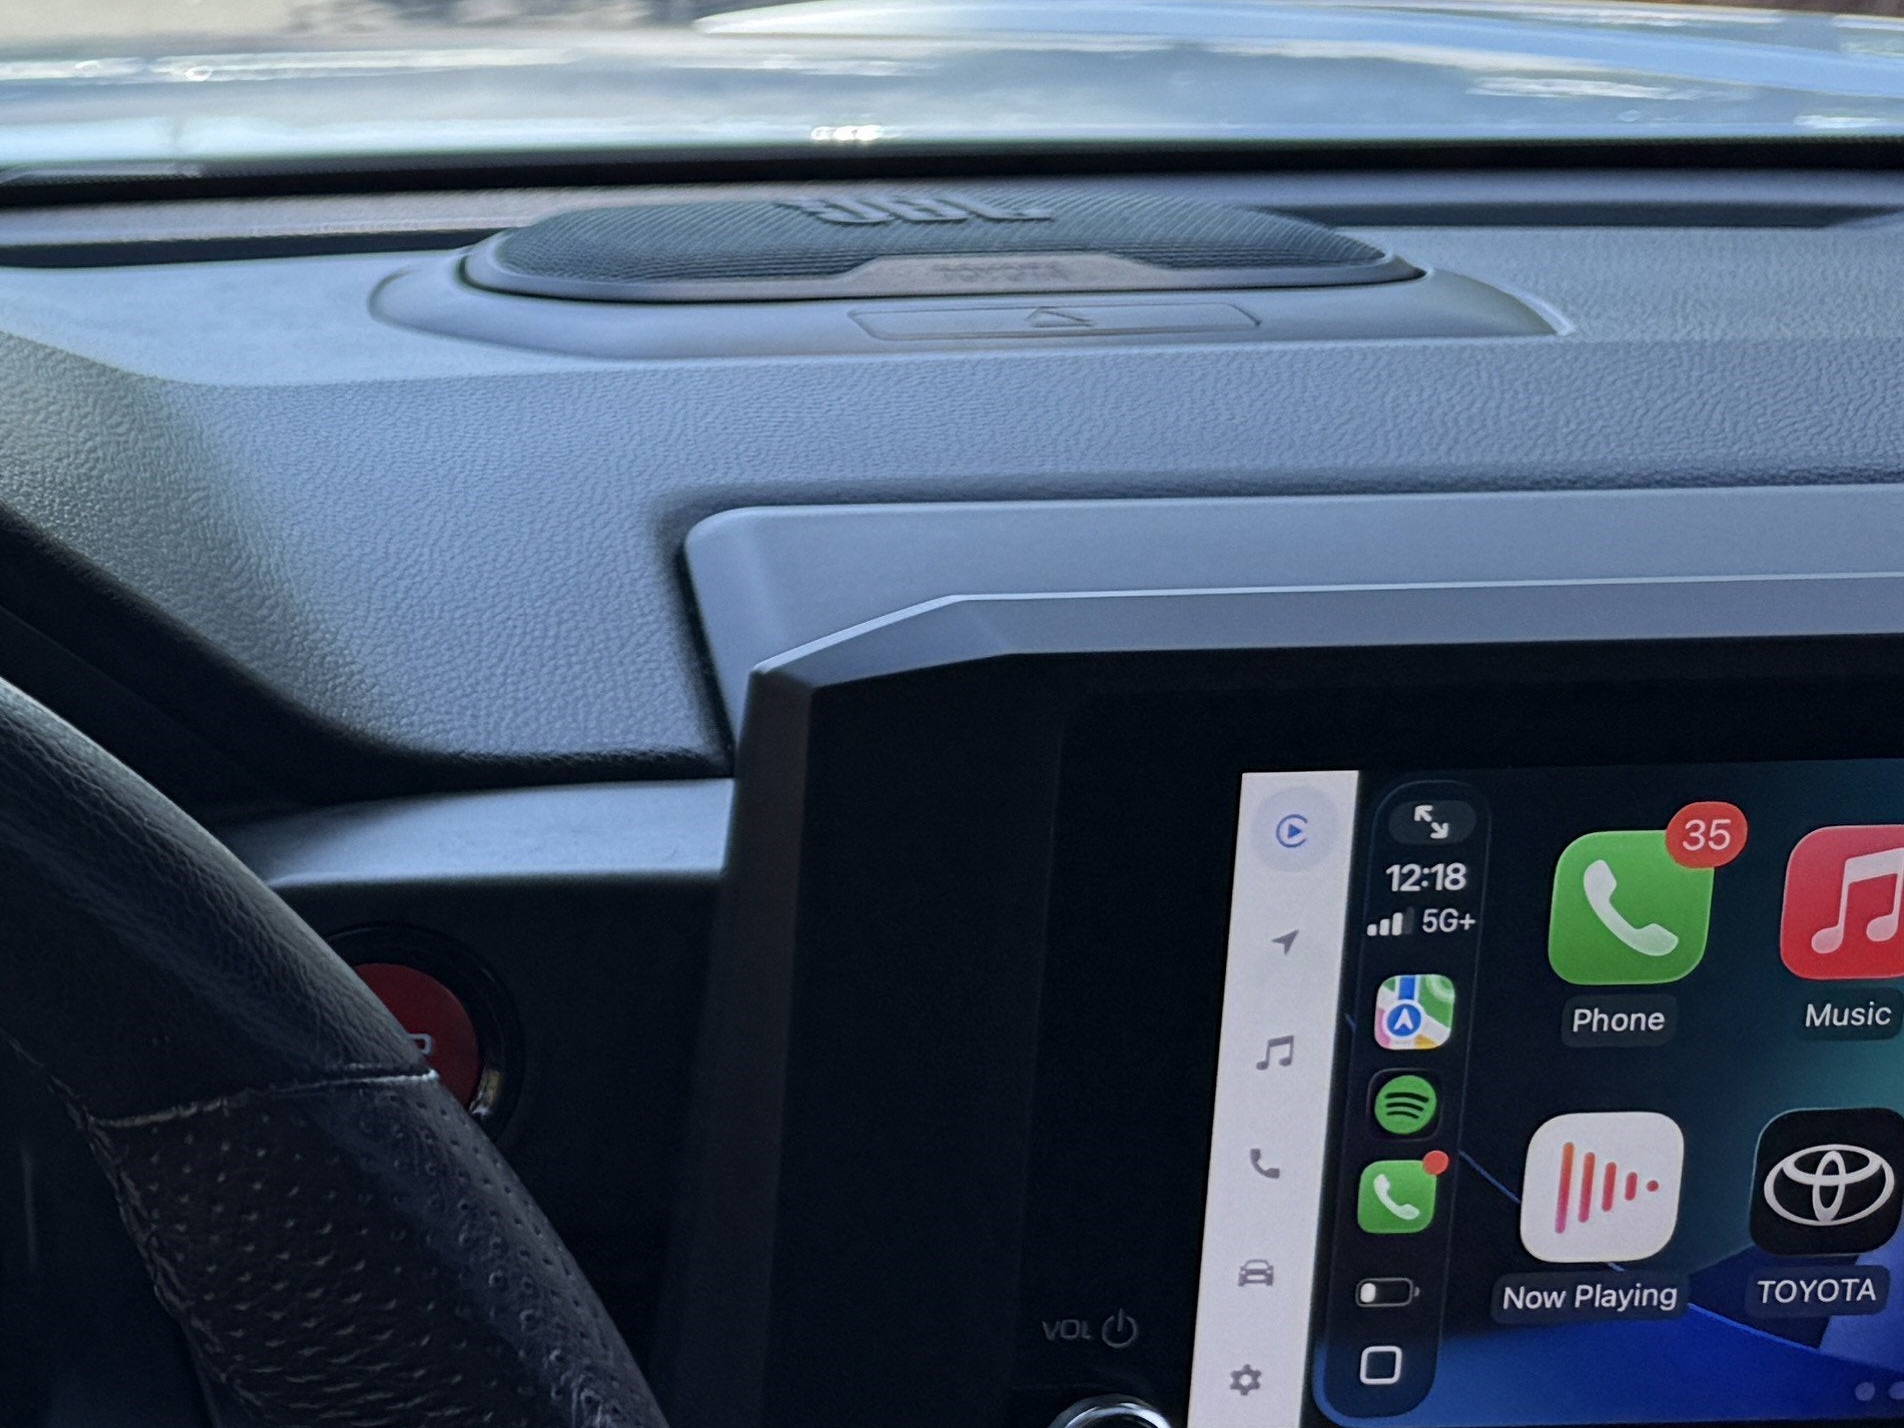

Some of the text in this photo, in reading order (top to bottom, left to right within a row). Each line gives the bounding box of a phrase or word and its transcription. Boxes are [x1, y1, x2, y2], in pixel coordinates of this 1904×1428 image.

[1681, 817, 1731, 852] 35
[1386, 863, 1466, 891] 12:18
[1423, 908, 1475, 932] 5G+
[1573, 1008, 1665, 1032] Phone
[1806, 1001, 1891, 1027] Music
[1504, 1283, 1677, 1311] Now Playing
[1758, 1279, 1876, 1303] TOYOTA
[1042, 1319, 1091, 1340] VOL
